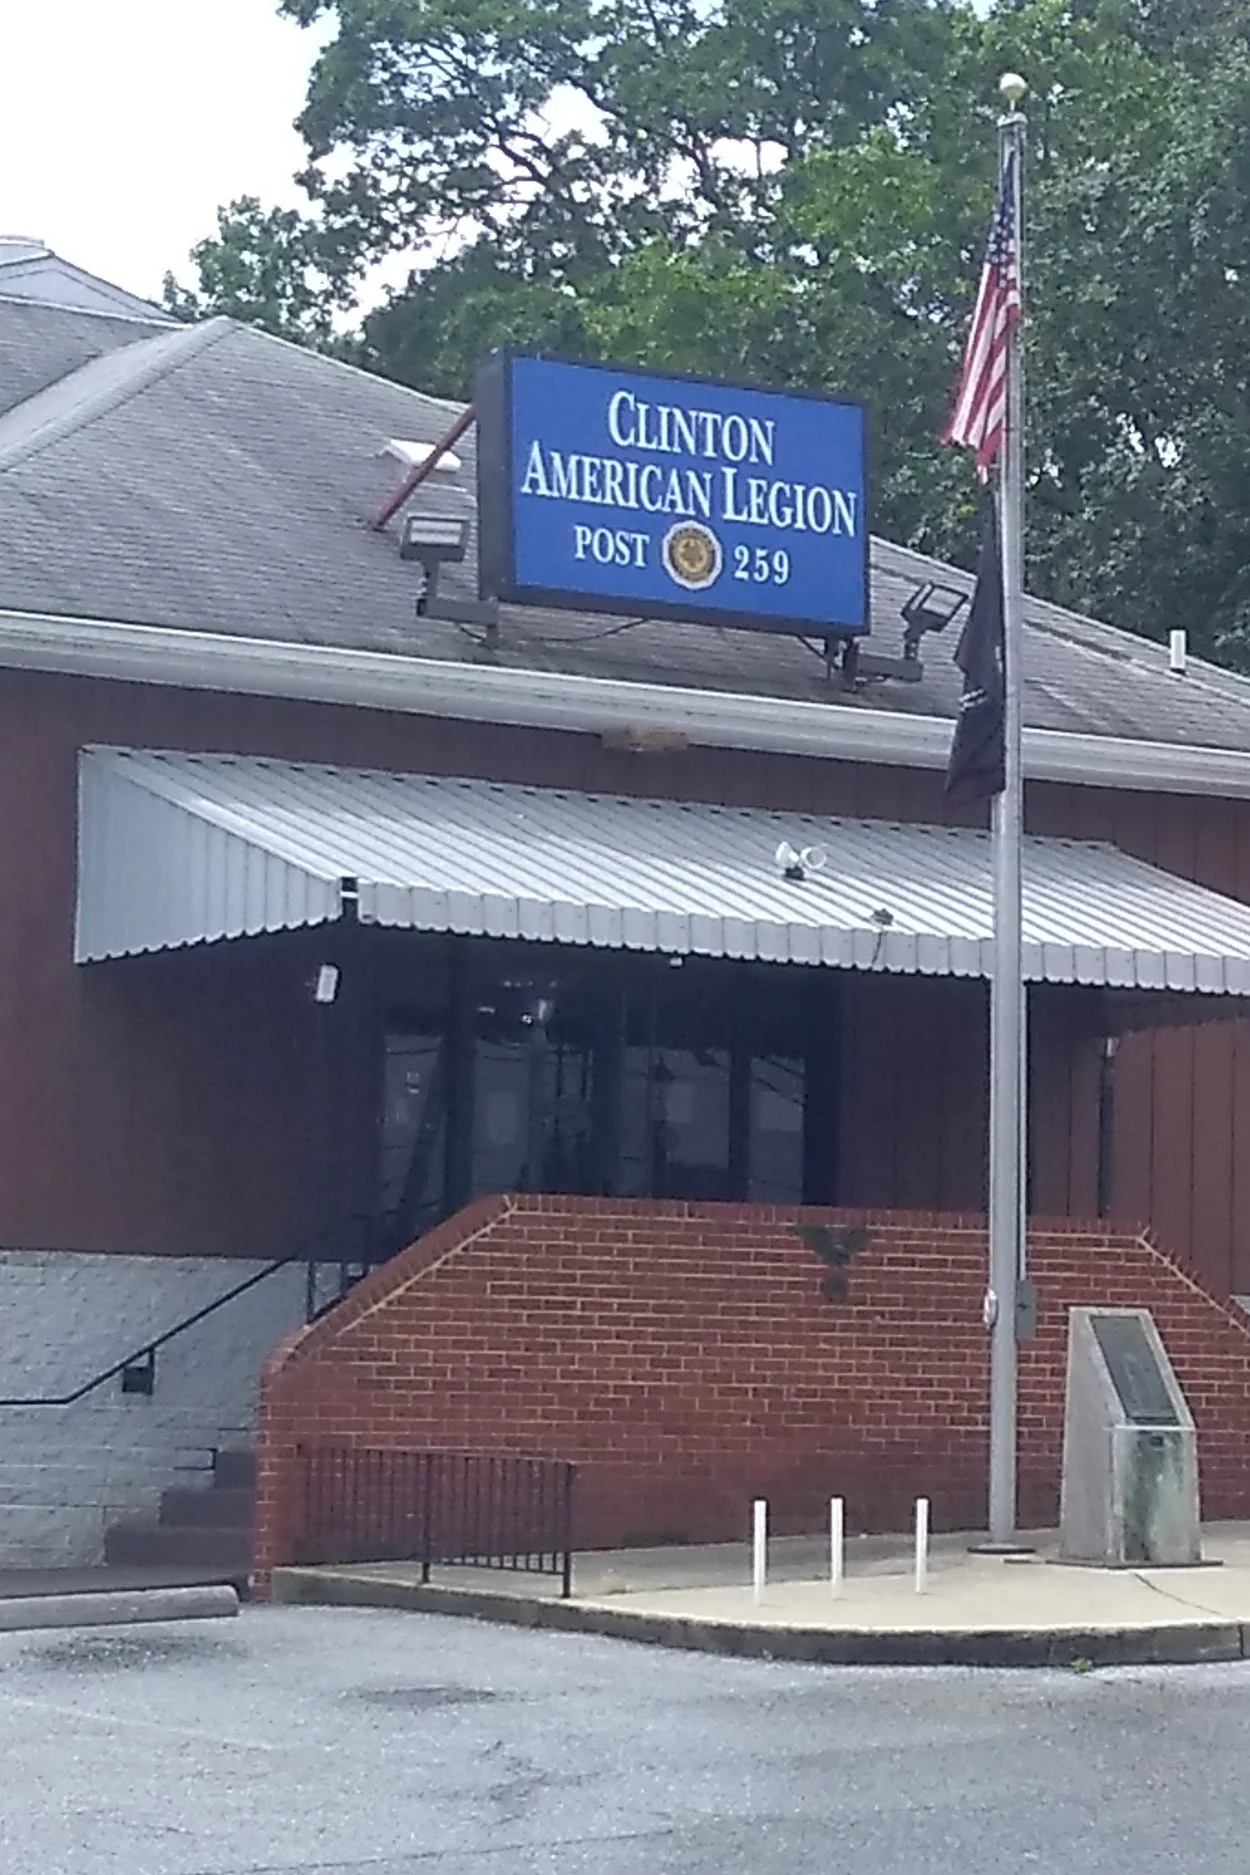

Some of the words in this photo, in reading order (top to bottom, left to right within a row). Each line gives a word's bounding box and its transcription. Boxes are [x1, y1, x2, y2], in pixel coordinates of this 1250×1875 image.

[608, 391, 775, 466] CLINTON
[521, 440, 711, 517] AMERICAN
[722, 466, 856, 537] LEGION
[574, 525, 649, 567] POST
[734, 546, 789, 584] 259
